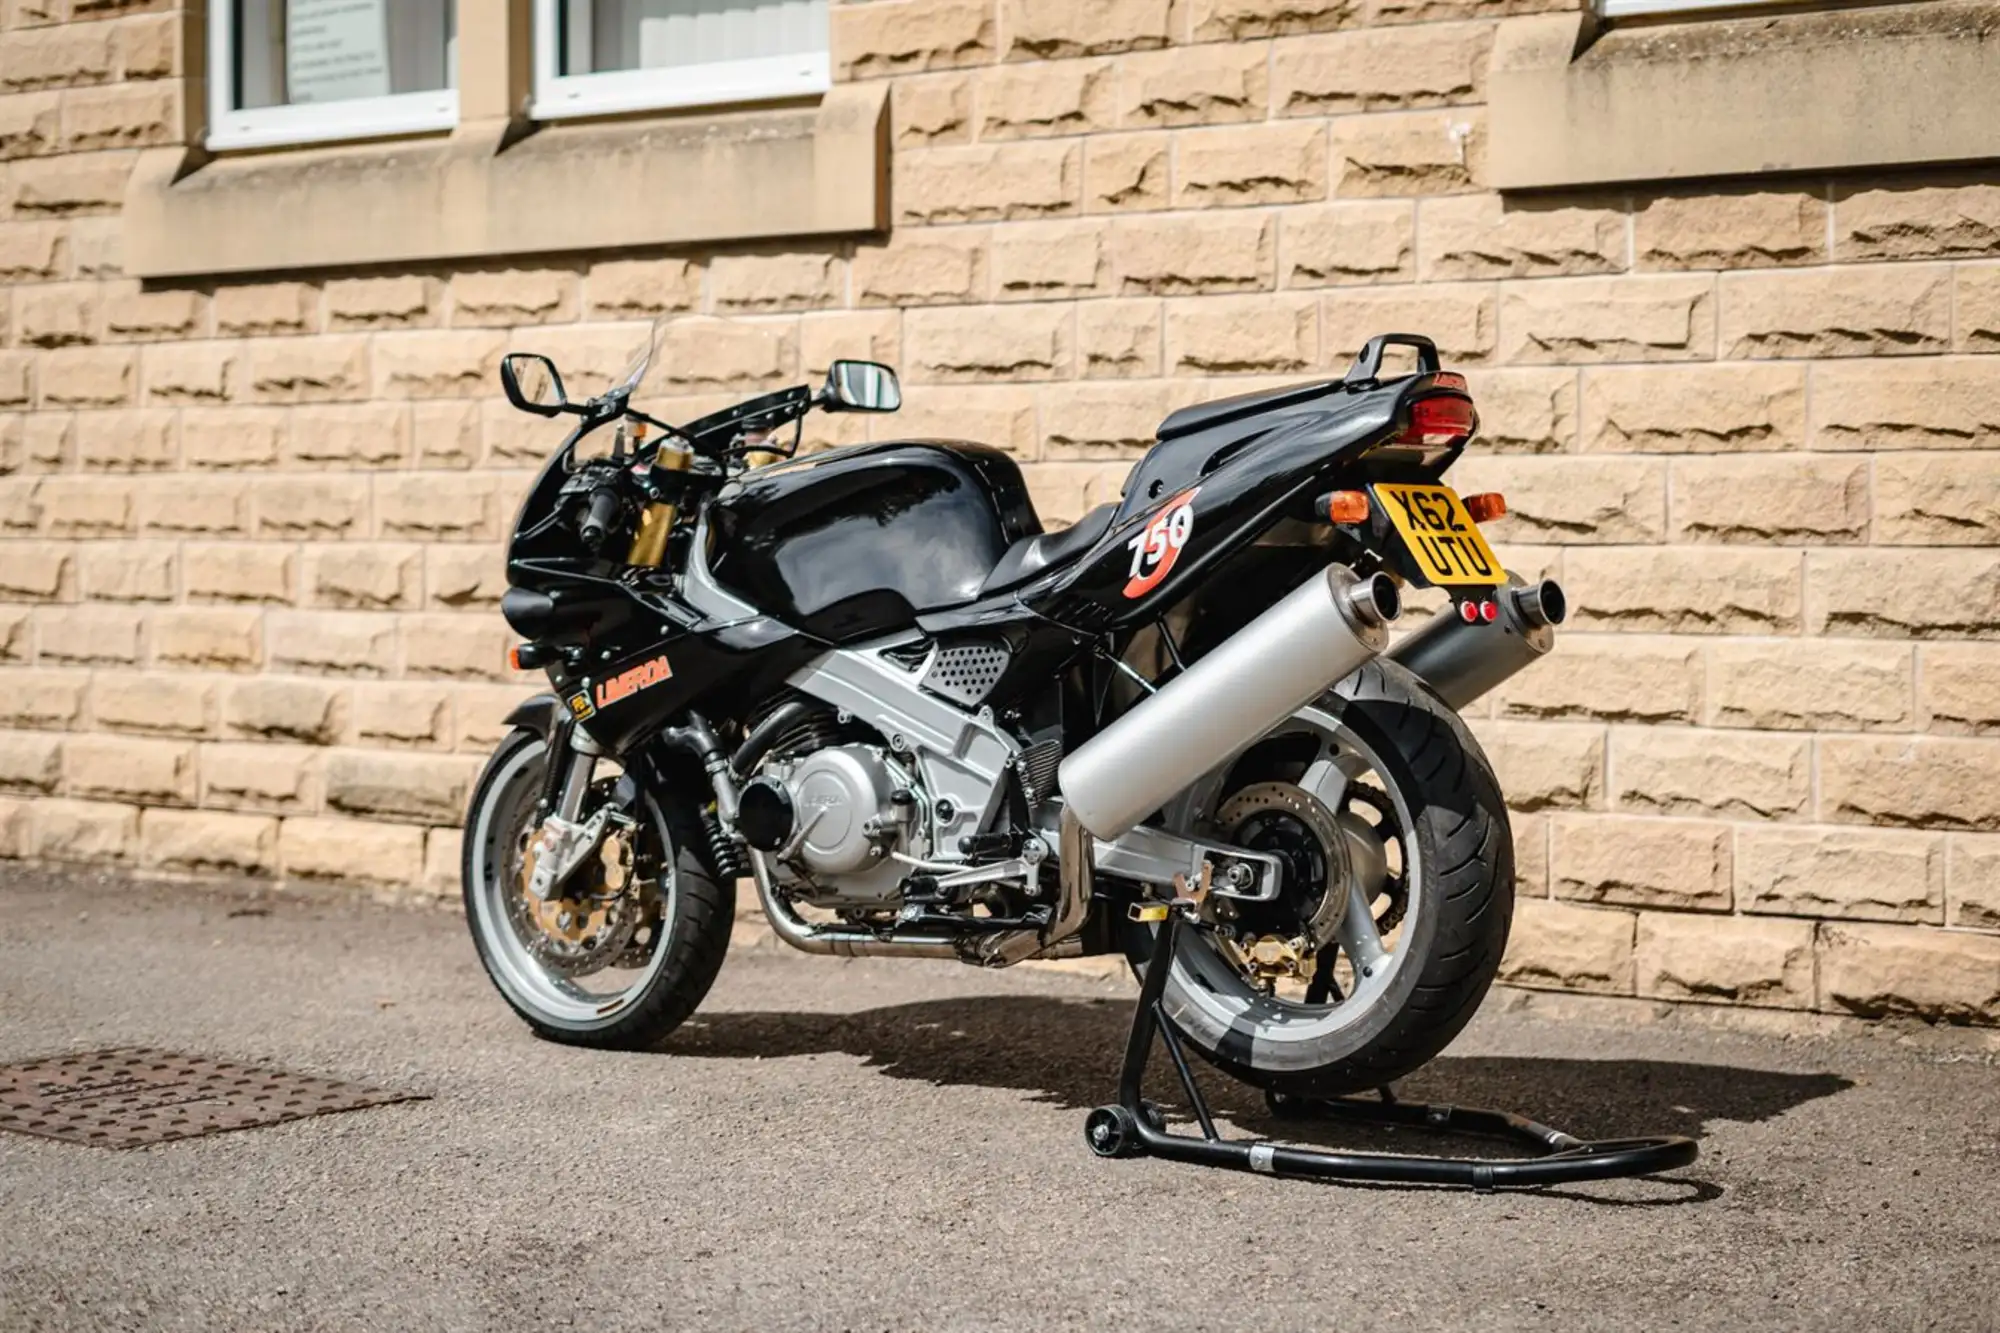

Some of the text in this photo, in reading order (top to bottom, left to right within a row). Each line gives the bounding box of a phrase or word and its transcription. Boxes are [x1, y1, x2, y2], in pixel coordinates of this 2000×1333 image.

[1388, 490, 1468, 532] X62
[1127, 503, 1194, 578] 750
[1416, 536, 1492, 576] UTU
